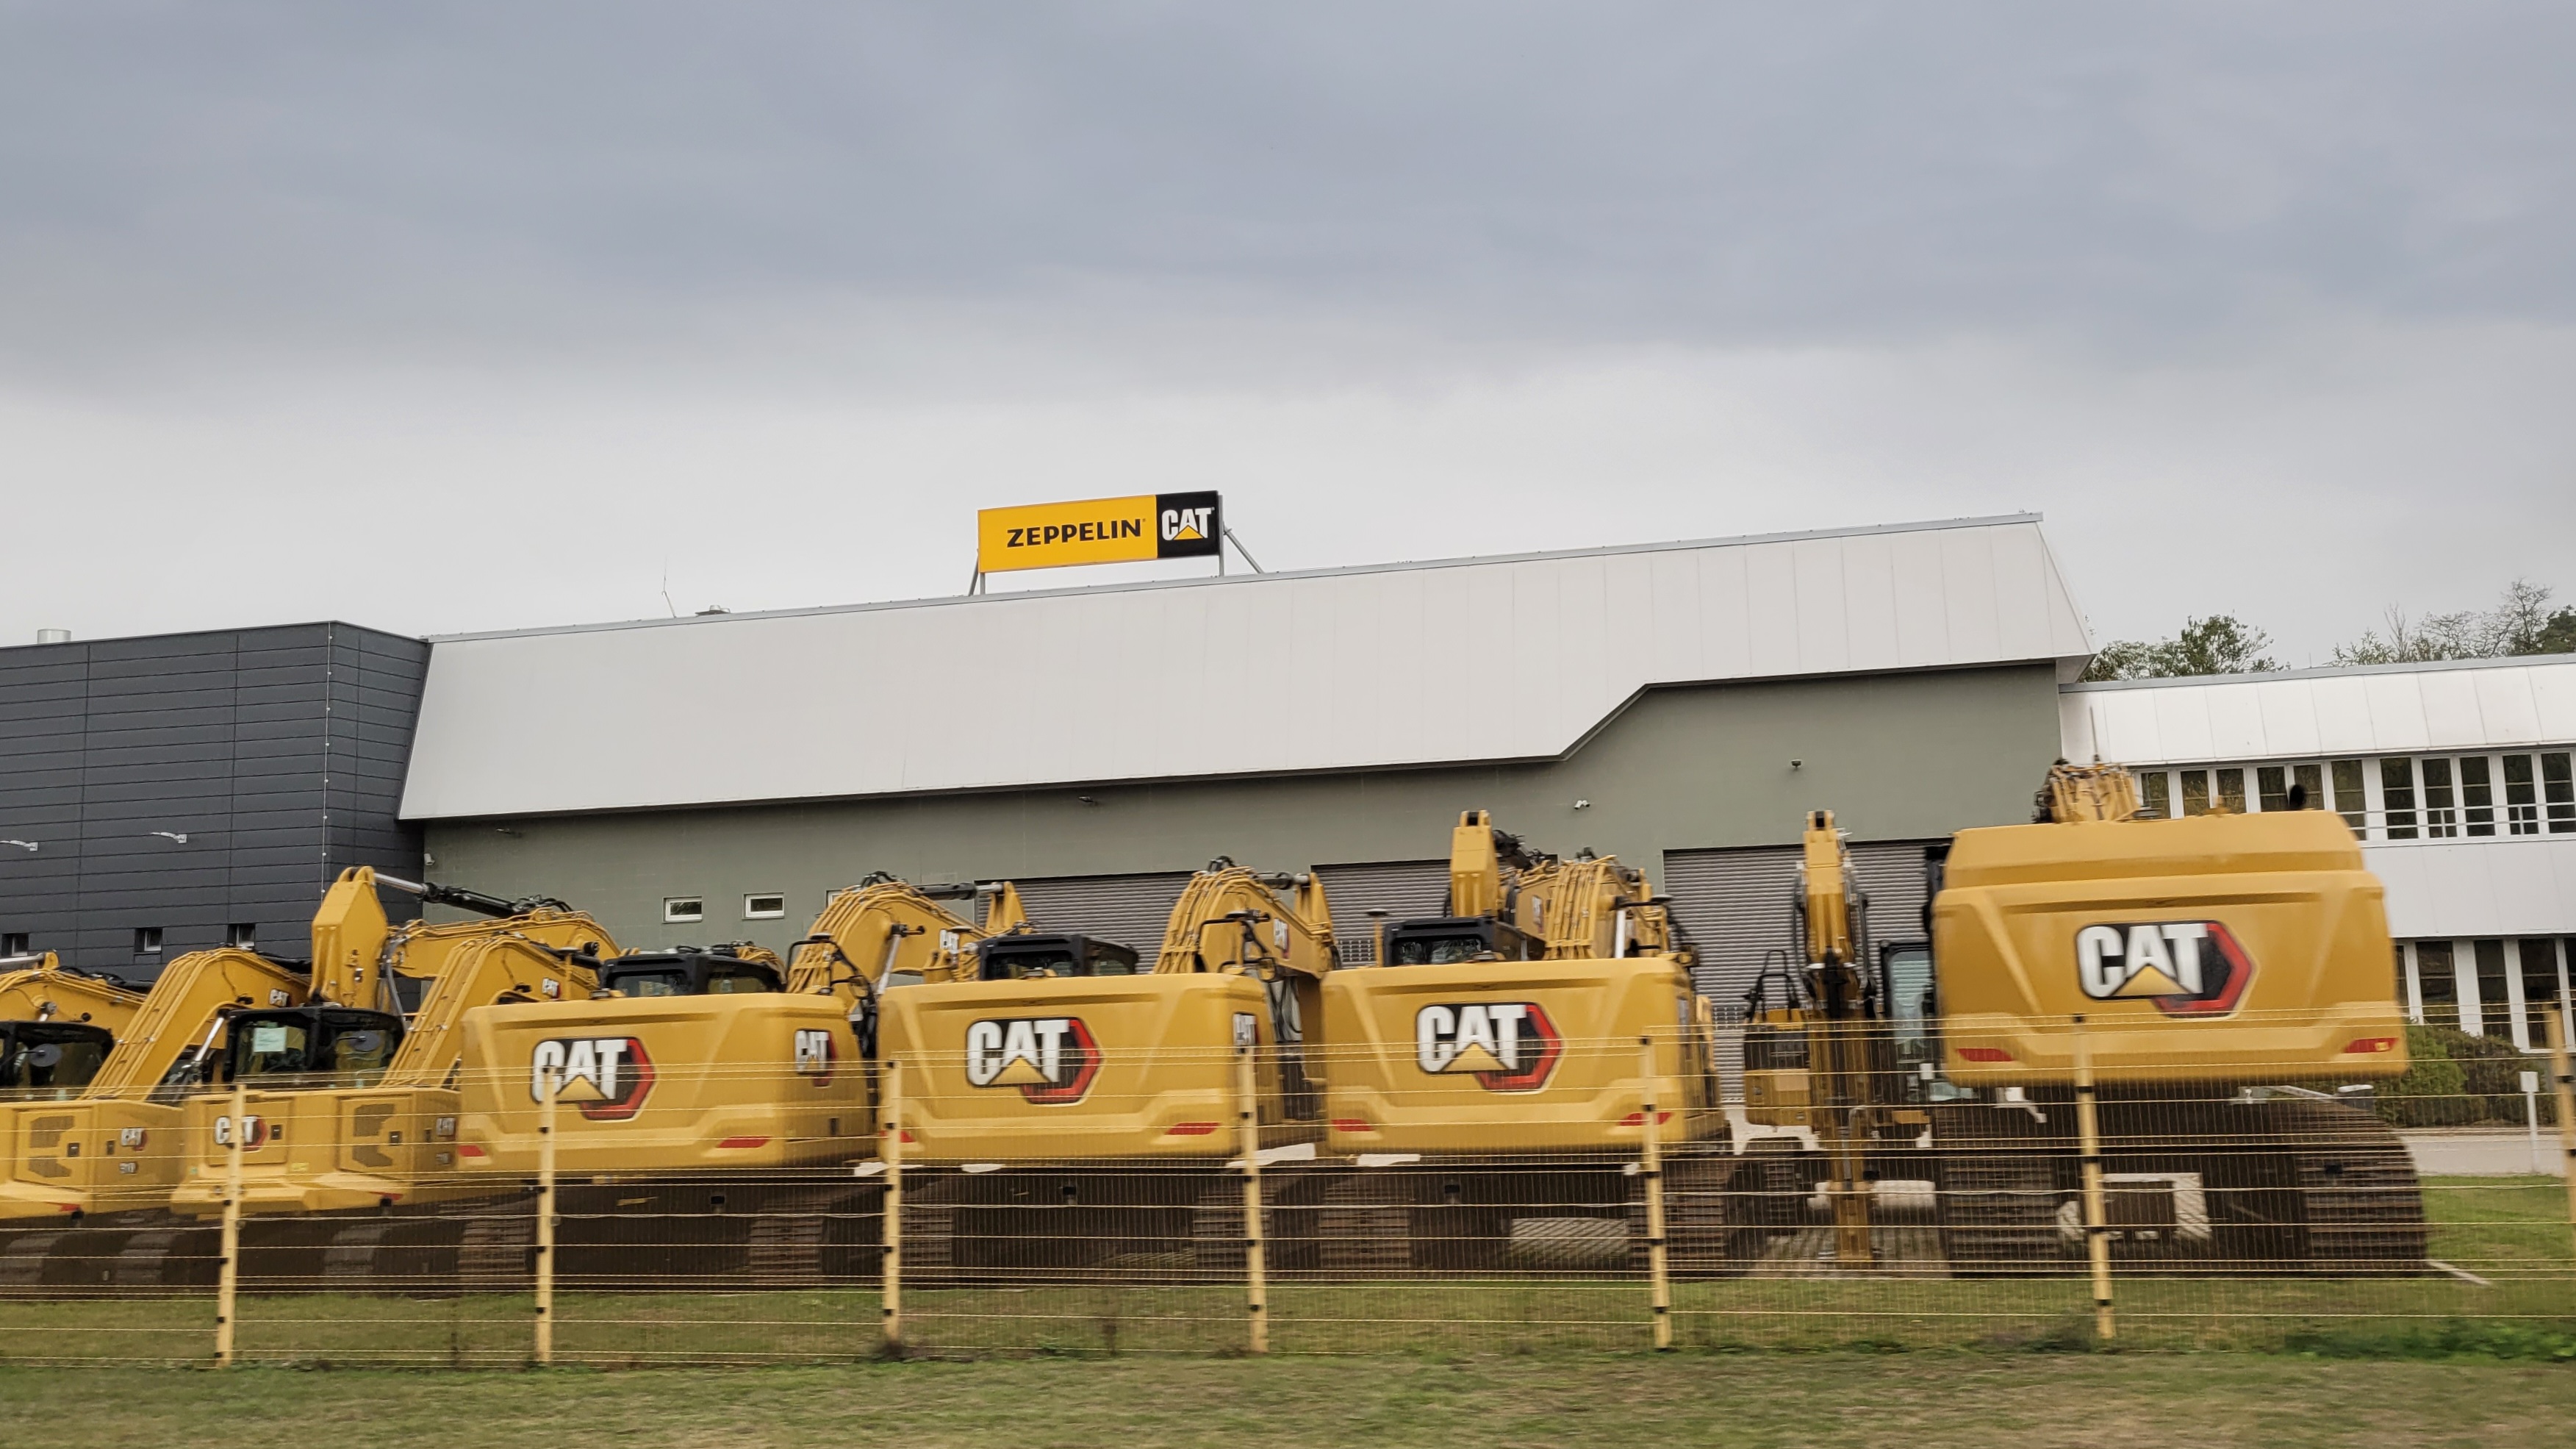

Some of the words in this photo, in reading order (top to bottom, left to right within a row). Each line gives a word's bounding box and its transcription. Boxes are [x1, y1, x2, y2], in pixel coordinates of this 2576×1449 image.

[1007, 518, 1141, 548] ZEPPELIN
[1162, 507, 1212, 540] CAT
[2077, 923, 2208, 997] CAT
[794, 1030, 829, 1073] CAT
[967, 1020, 1069, 1085] CAT
[1417, 1005, 1526, 1072] CAT
[532, 1040, 628, 1102] CAT
[121, 1128, 145, 1145] CAT
[215, 1116, 257, 1144] CT
